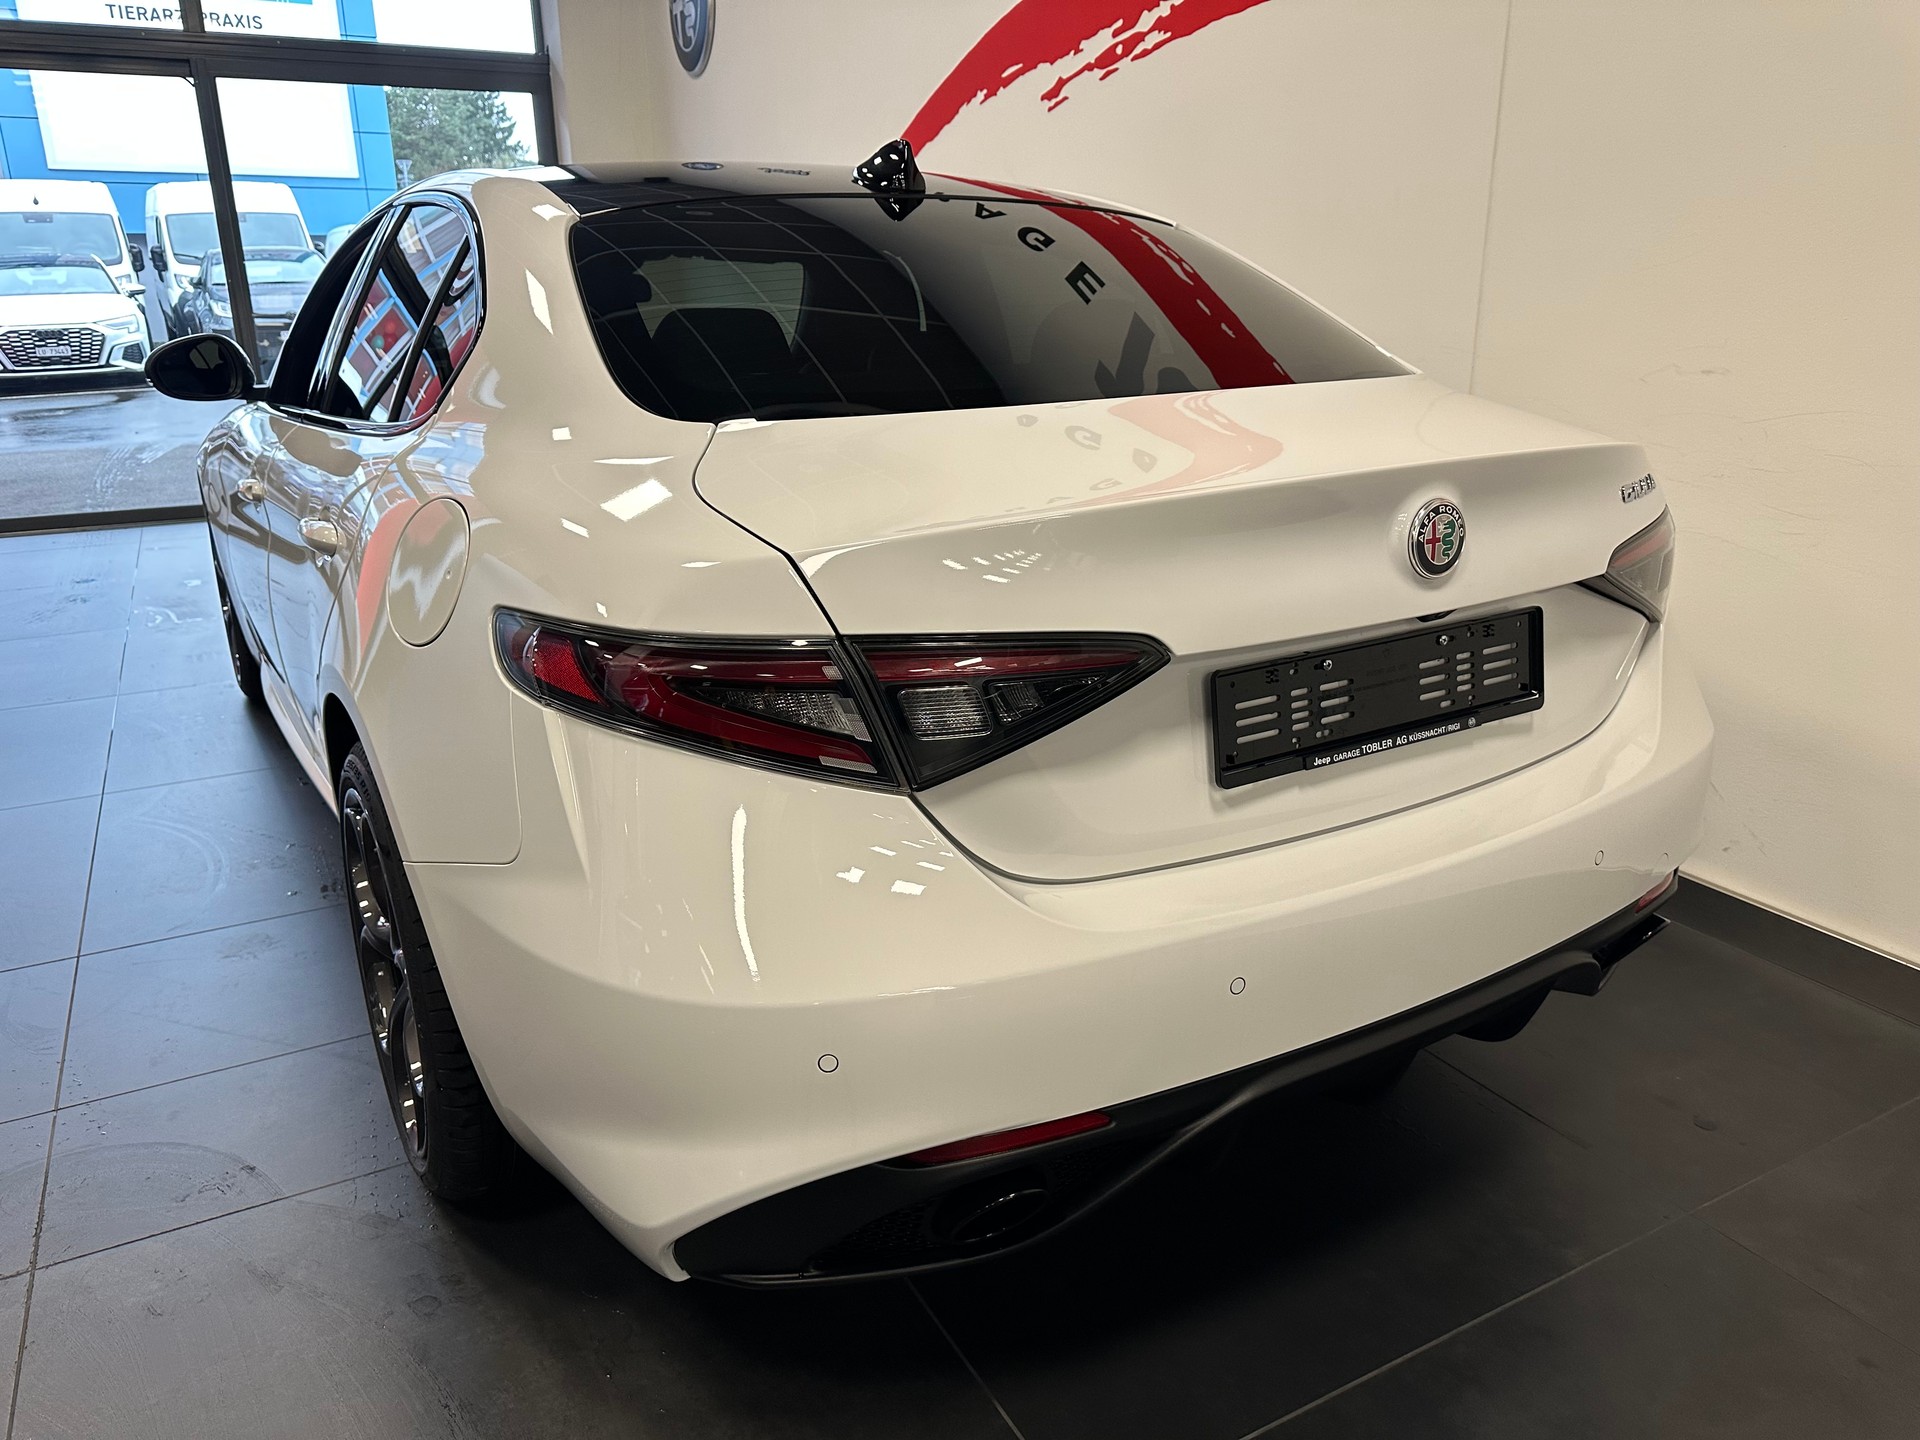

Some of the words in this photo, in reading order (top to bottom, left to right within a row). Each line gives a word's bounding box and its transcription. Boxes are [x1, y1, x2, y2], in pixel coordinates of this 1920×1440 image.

[105, 4, 263, 30] TIERARZRAXIS
[1418, 511, 1436, 543] ALFA
[1439, 505, 1464, 537] ROMEO
[1313, 757, 1331, 766] Jeep
[1333, 748, 1361, 762] GARAGE
[1361, 738, 1393, 755] TOBLER
[1396, 734, 1408, 746] AG
